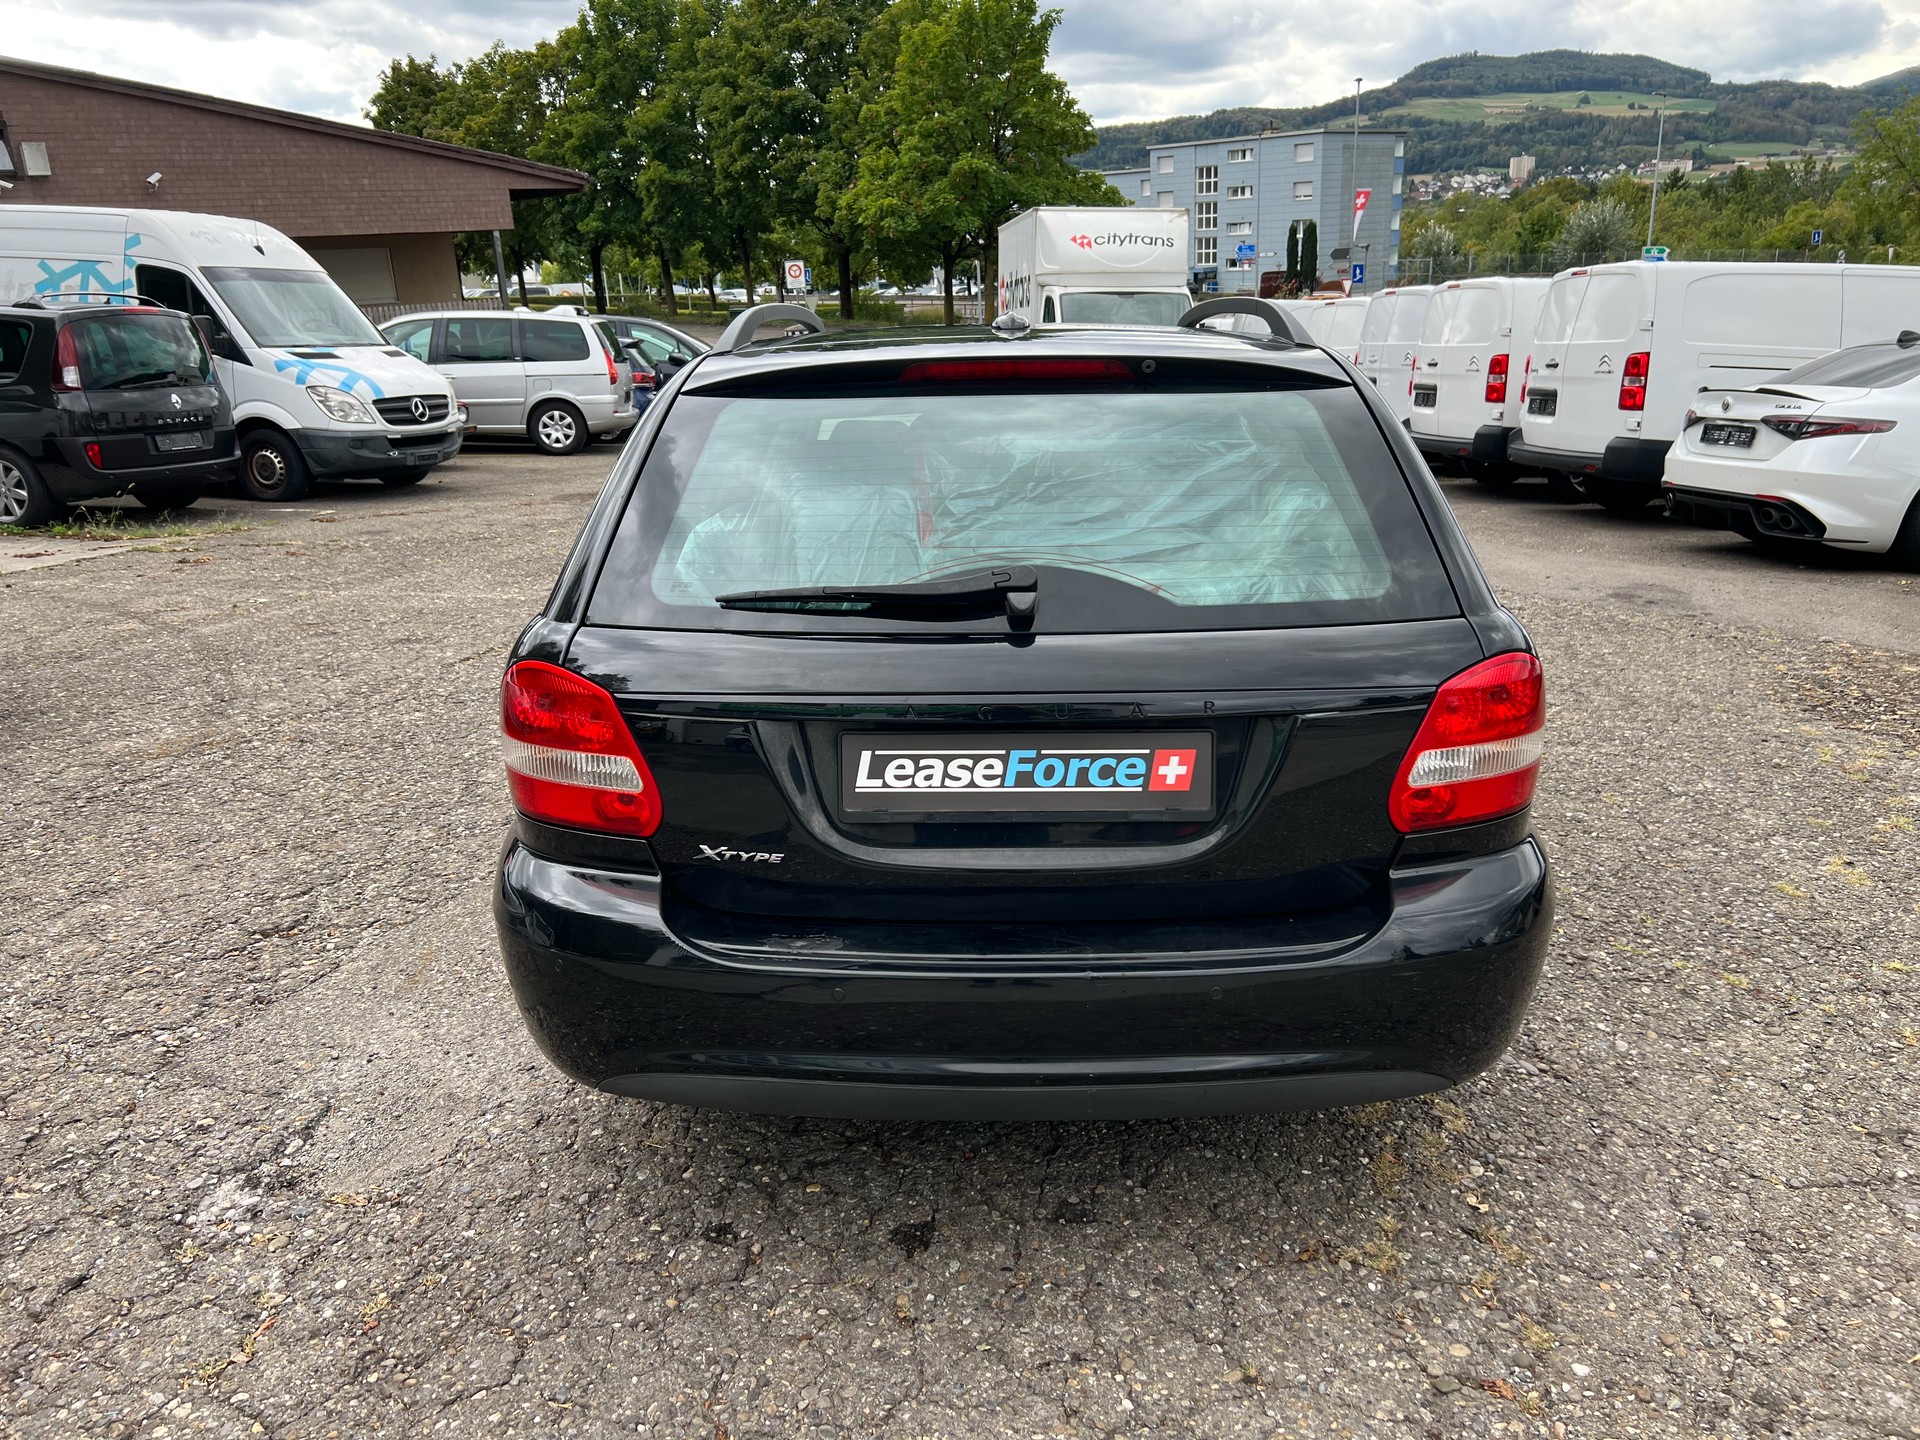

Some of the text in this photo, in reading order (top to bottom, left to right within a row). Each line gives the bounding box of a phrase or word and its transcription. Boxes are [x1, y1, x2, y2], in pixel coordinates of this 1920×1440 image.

[1094, 233, 1175, 248] citytrans
[157, 416, 203, 425] ESPACE
[855, 750, 1147, 789] LeaseForce
